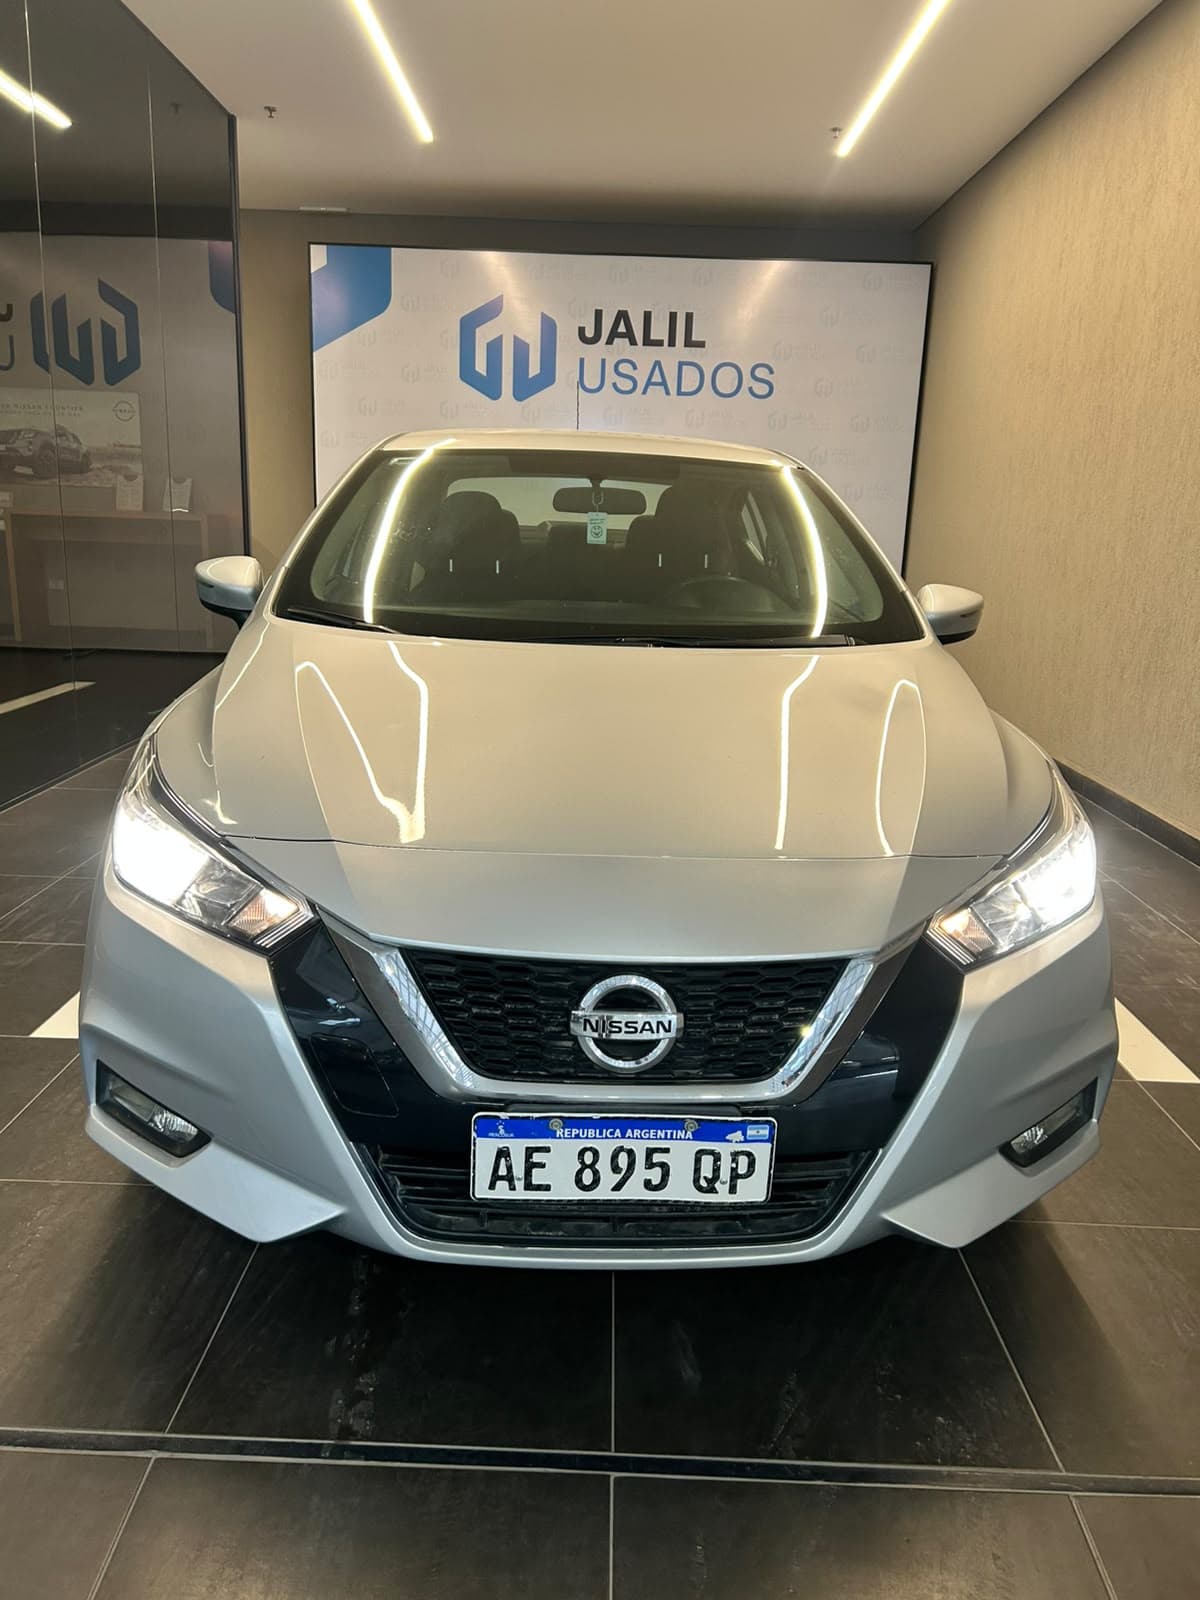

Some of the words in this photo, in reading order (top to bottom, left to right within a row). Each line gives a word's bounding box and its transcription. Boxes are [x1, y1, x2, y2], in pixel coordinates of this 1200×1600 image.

[577, 309, 706, 349] JALIL
[578, 357, 775, 400] USADOS
[582, 1018, 672, 1034] NISSAN
[556, 1128, 621, 1138] REPUBLICA
[625, 1129, 693, 1140] ARGENTINA
[487, 1146, 552, 1192] AE
[574, 1146, 671, 1192] 895
[692, 1148, 756, 1195] QP
